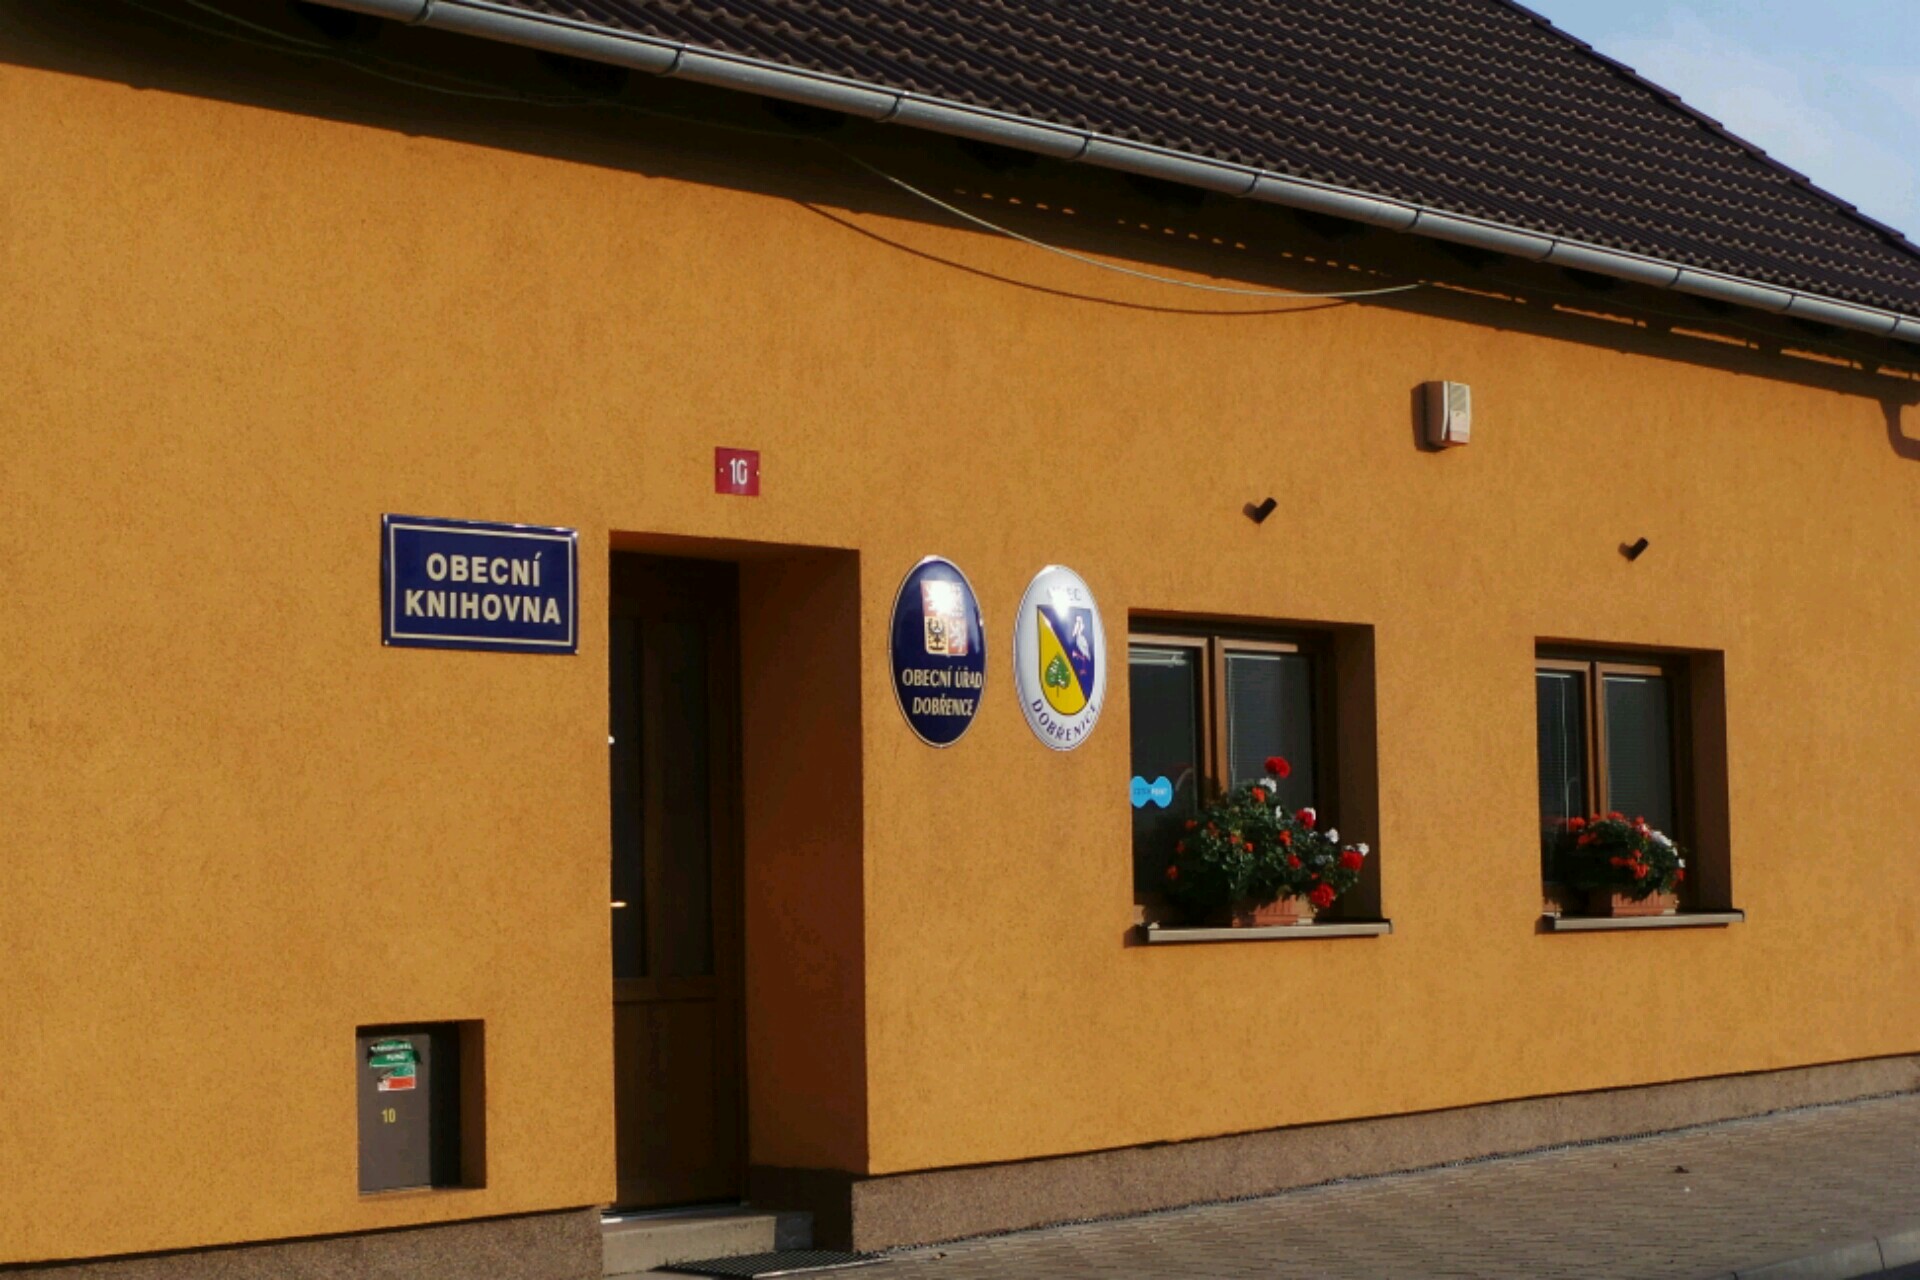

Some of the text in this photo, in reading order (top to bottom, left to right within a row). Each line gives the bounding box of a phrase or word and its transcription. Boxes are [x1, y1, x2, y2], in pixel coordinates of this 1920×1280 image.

[426, 551, 542, 587] OBECNÍ
[405, 589, 562, 625] KNIHOVNA
[902, 665, 983, 689] OBECNÍ ÚŘAD
[912, 693, 974, 716] DOBŘENICE
[1032, 699, 1099, 741] DOBŘENICE
[382, 1108, 396, 1123] 10
